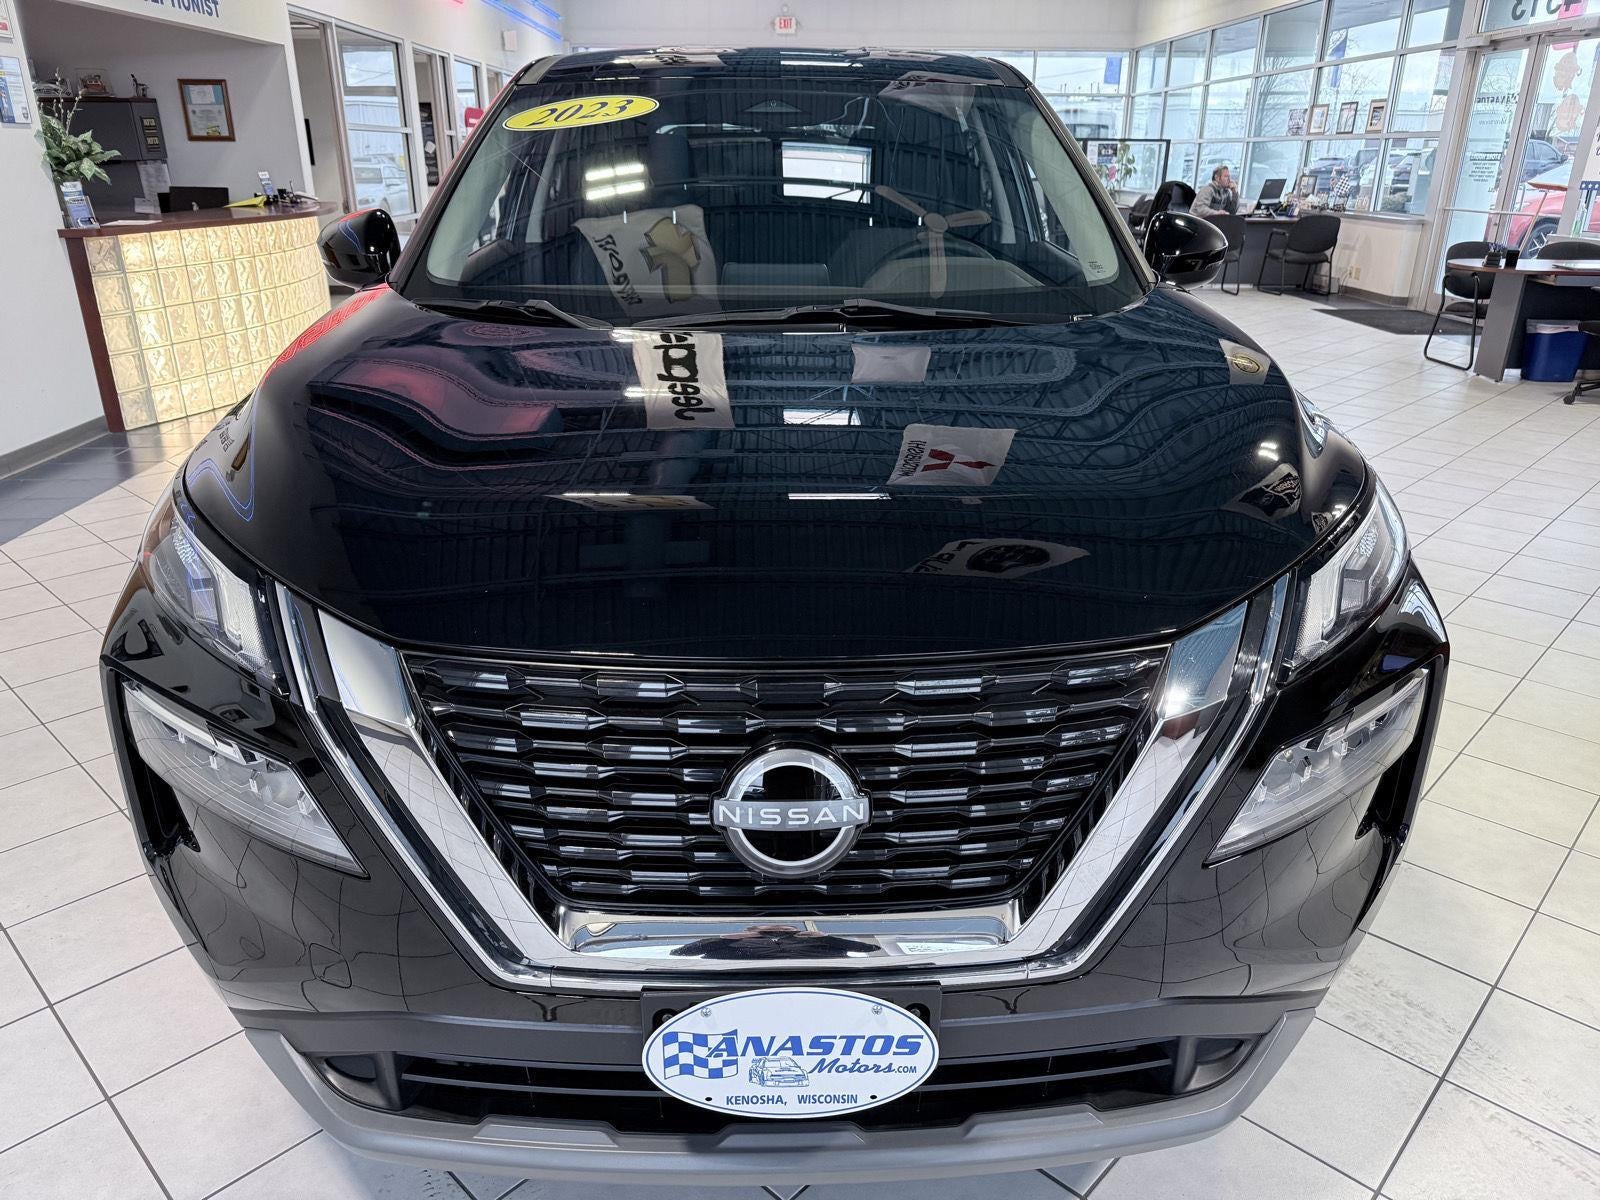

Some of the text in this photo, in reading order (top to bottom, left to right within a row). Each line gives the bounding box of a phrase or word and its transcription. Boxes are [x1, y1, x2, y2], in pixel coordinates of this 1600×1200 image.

[779, 18, 793, 29] EXIT
[526, 98, 634, 128] 2023
[718, 803, 864, 825] NISSAN
[705, 1034, 924, 1058] ANASTOS
[726, 1094, 858, 1107] KENOSHA, WISCONSIN
